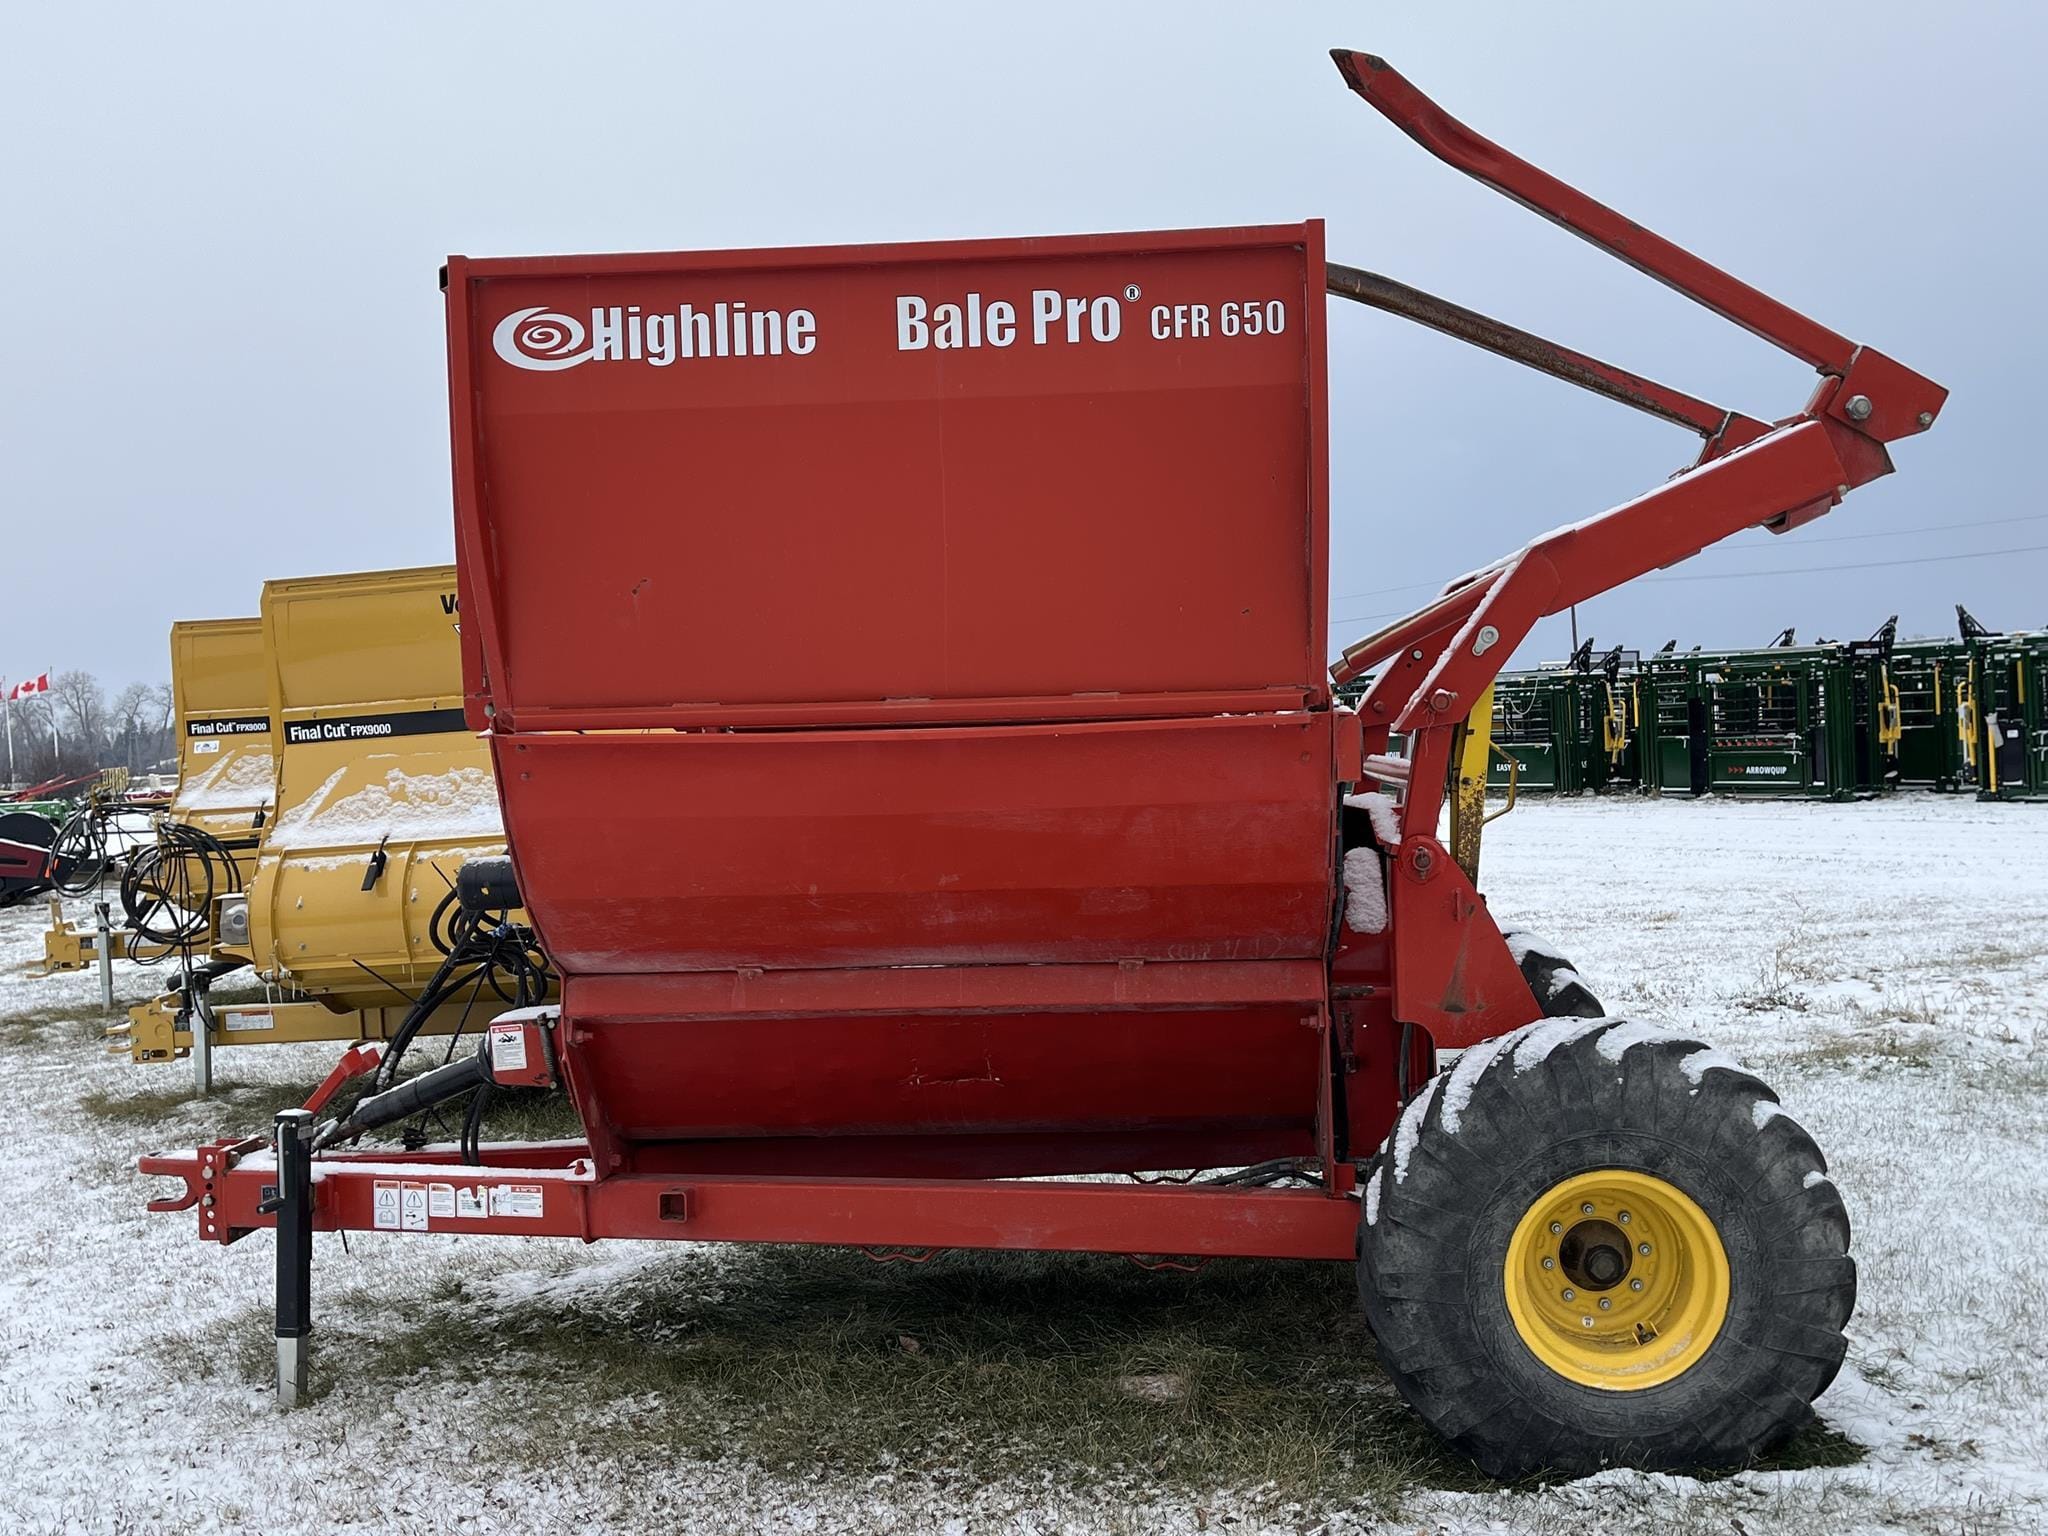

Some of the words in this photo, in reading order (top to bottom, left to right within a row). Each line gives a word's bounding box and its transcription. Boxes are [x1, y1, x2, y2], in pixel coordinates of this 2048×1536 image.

[896, 292, 1017, 351] Bale
[1150, 304, 1210, 340] CFR
[1220, 299, 1286, 337] 650
[591, 302, 817, 366] Highline
[191, 723, 215, 735] Final
[290, 725, 322, 741] Final
[350, 723, 392, 737] FPX9000
[1745, 766, 1788, 776] ARROWQUIP
